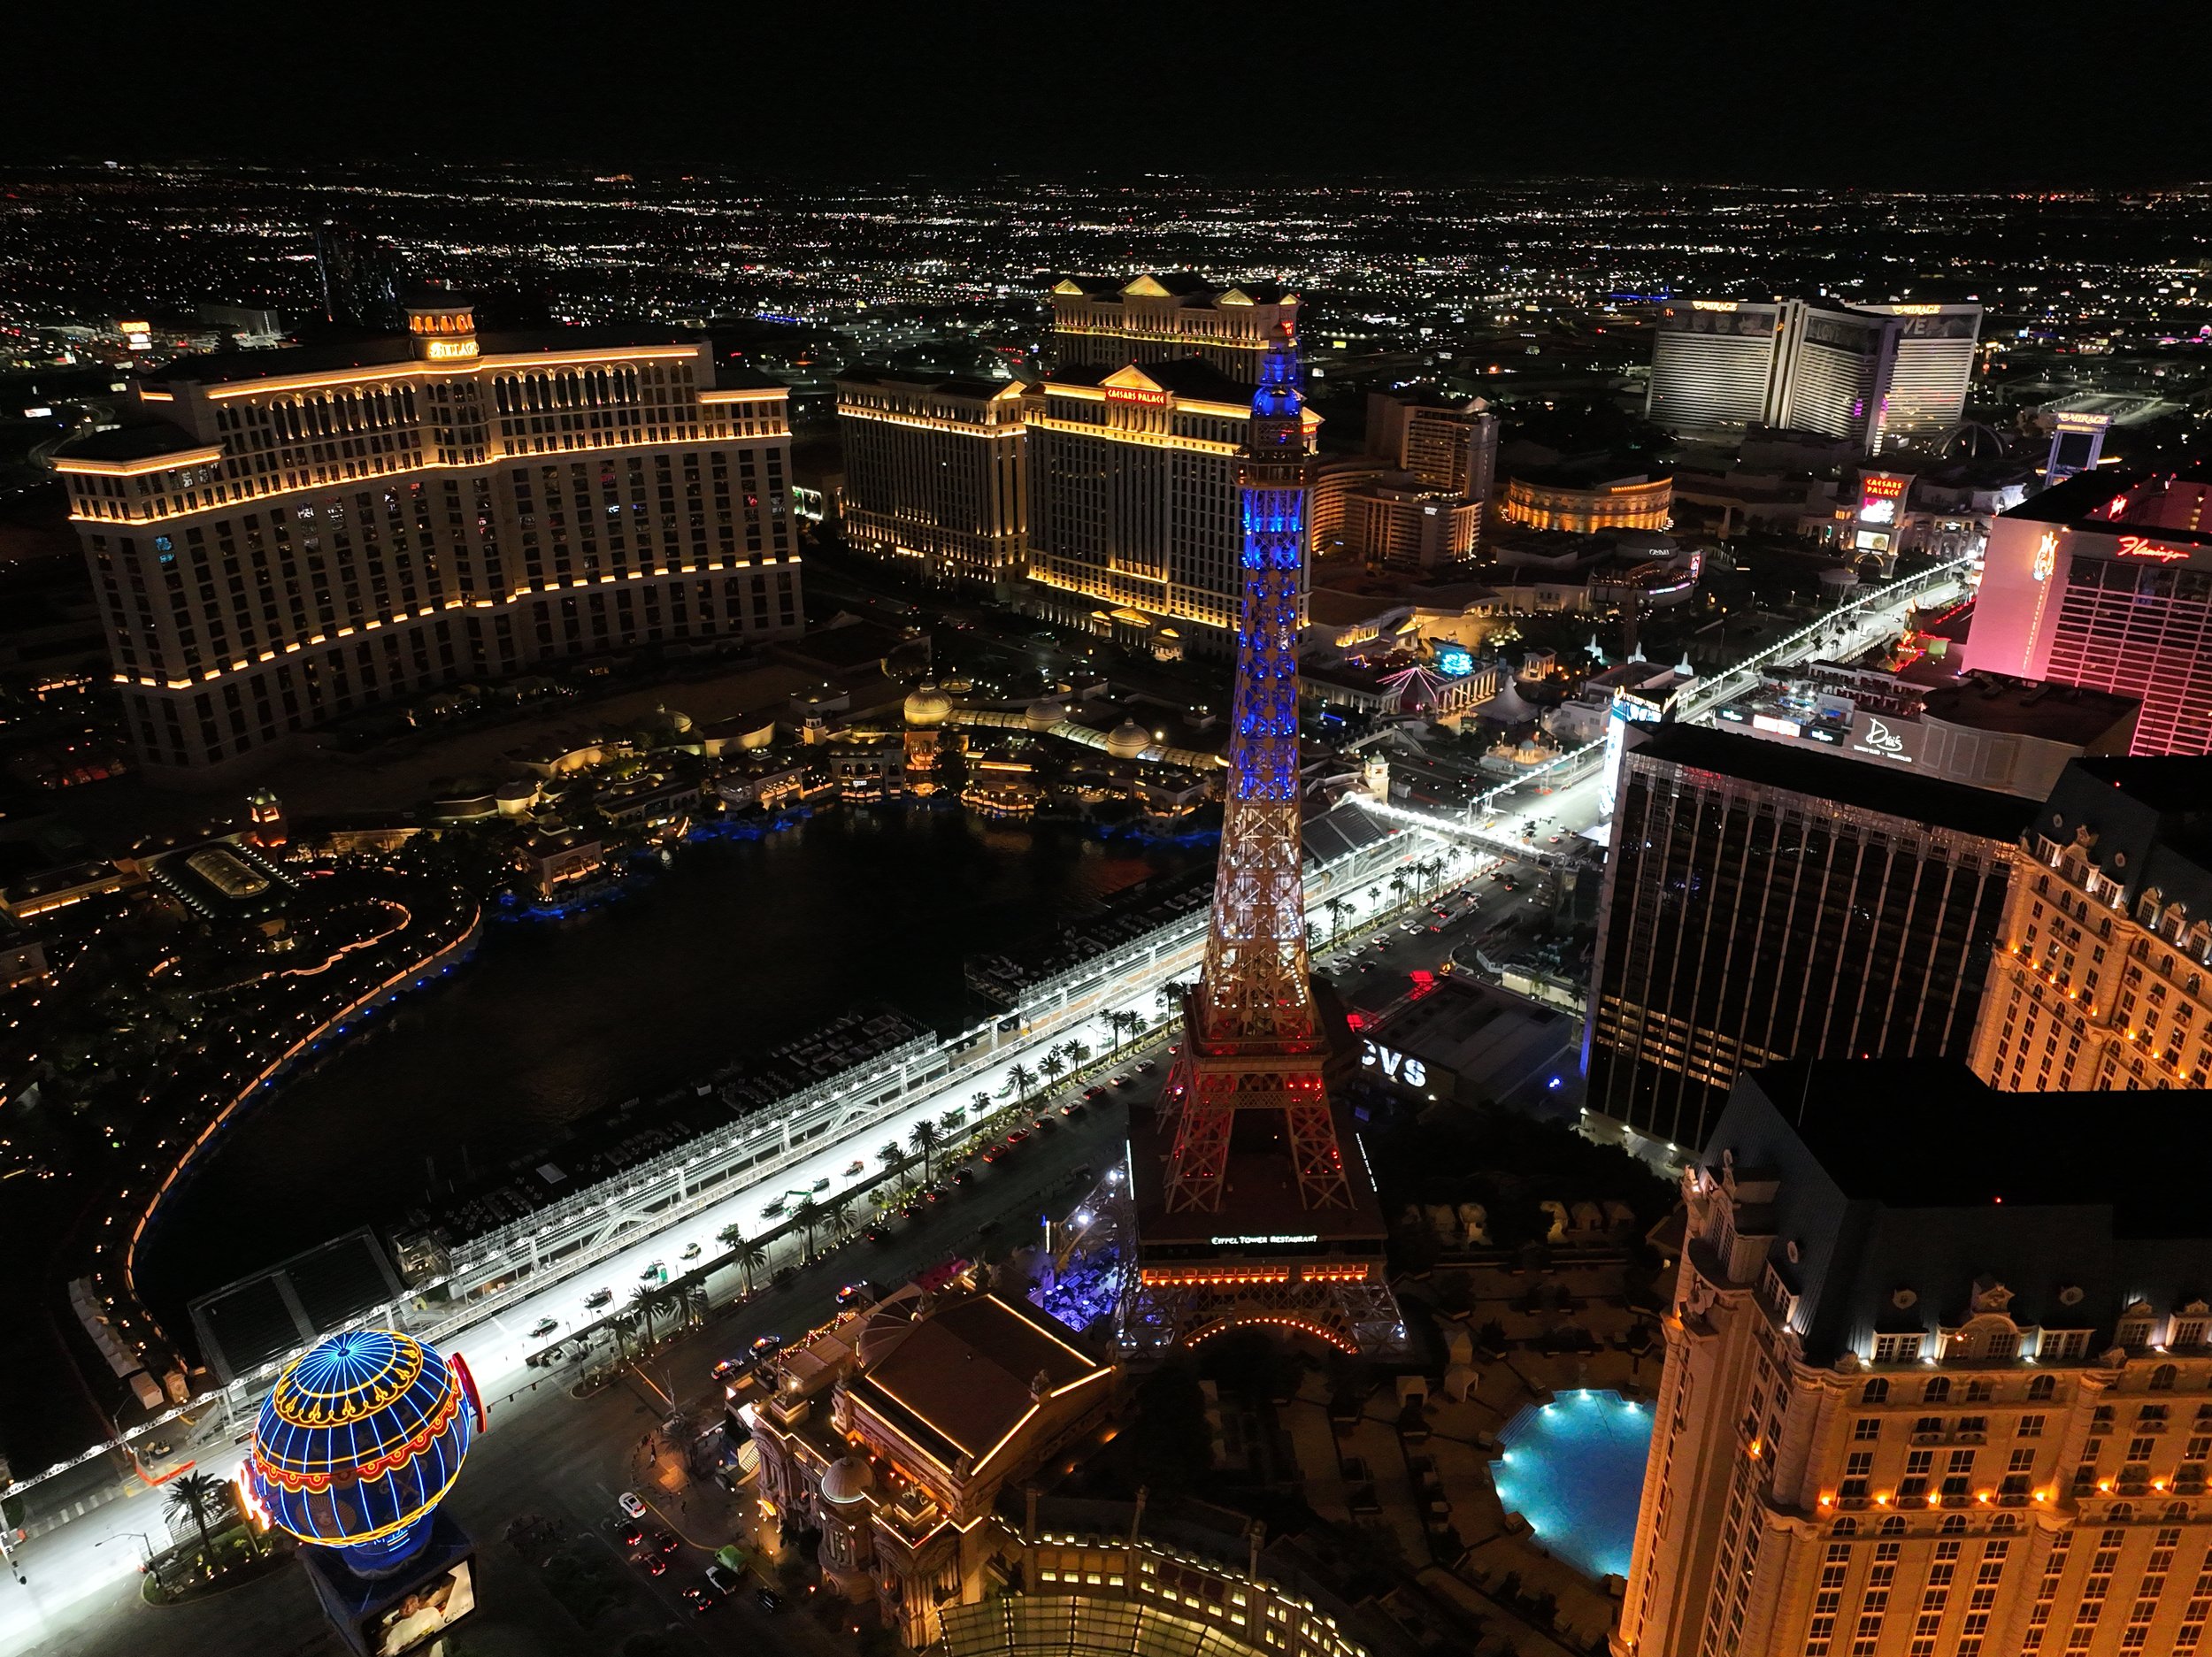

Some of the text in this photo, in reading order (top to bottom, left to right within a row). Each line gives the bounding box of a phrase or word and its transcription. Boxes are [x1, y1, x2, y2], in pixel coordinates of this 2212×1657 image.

[1107, 389, 1164, 404] CAESARS PALACE
[2066, 413, 2109, 425] MIRAGE
[1866, 479, 1902, 489] CAESARS
[1867, 486, 1900, 496] PALACE
[2117, 536, 2190, 563] Flamingo
[1239, 1235, 1268, 1244] TOWER
[1270, 1234, 1318, 1244] RESTAURANT
